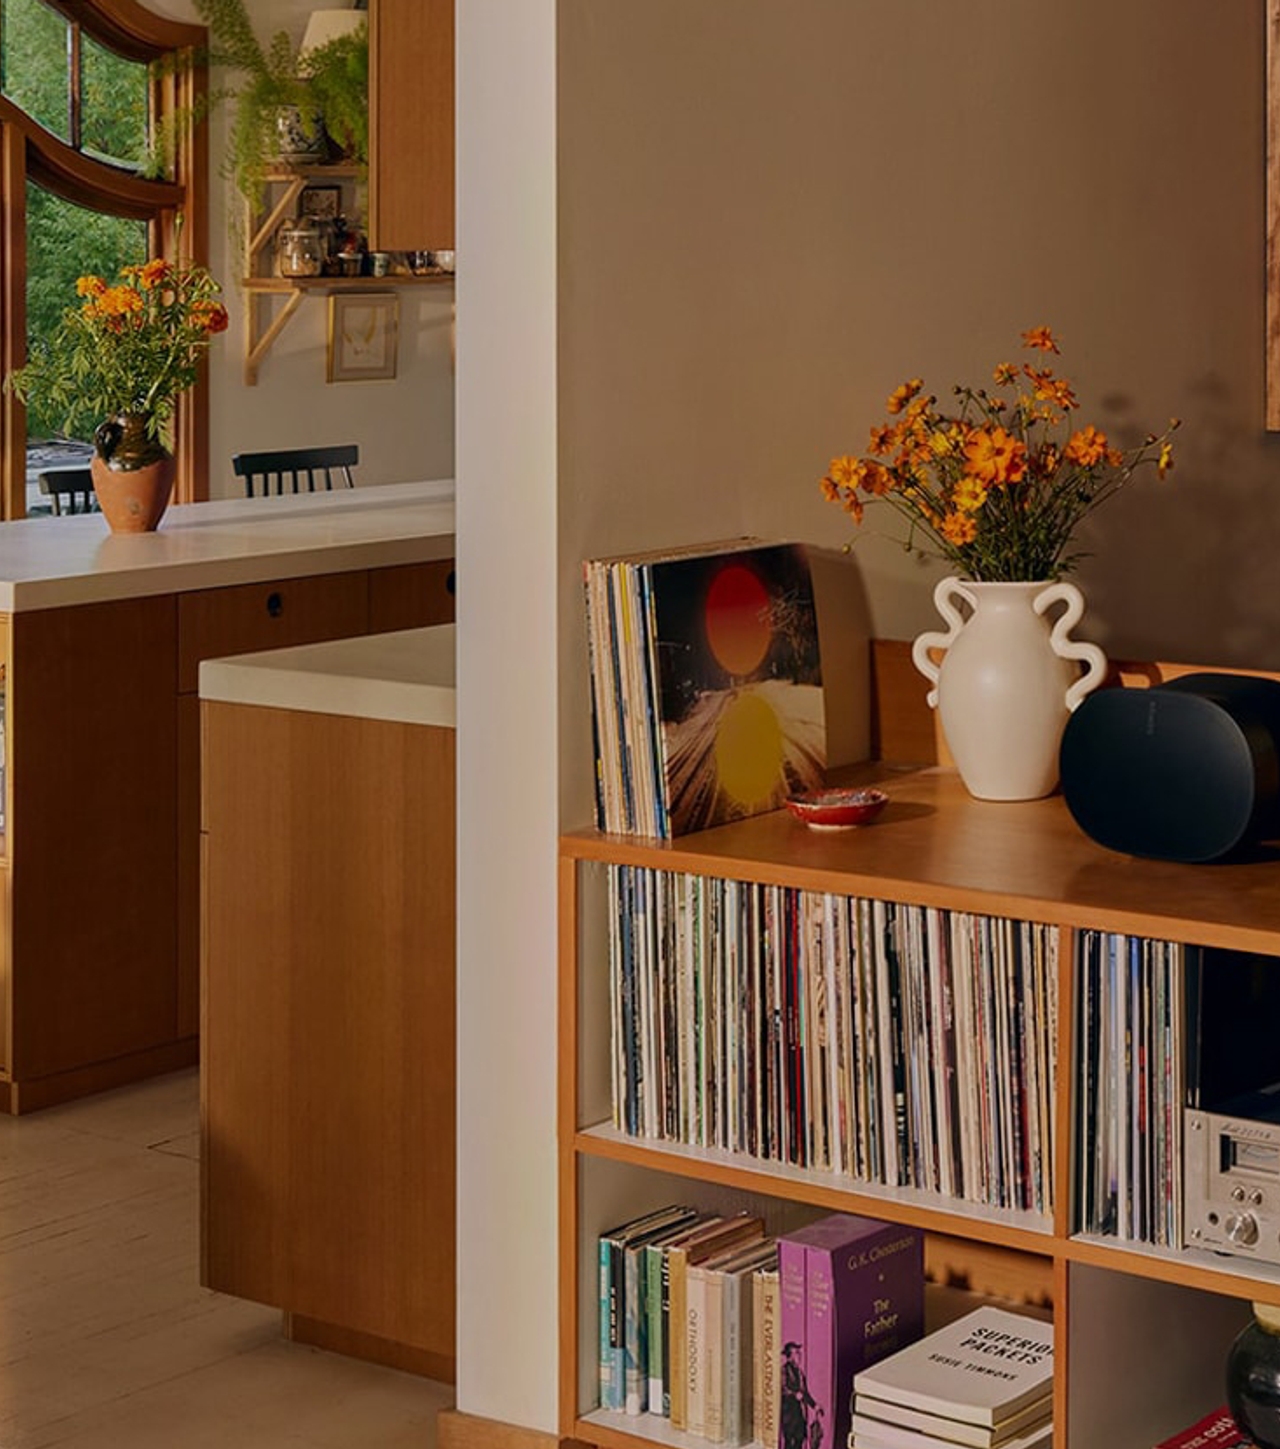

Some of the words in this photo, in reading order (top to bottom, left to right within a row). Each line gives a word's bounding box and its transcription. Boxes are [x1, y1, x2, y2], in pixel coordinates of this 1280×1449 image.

[764, 1295, 773, 1317] THE
[873, 1298, 890, 1313] The
[688, 1309, 698, 1393] ORTHODOXY
[763, 1320, 773, 1397] EVERLASTING
[960, 1338, 1042, 1366] PACKETS
[928, 1353, 961, 1368] SUSIE
[965, 1363, 1018, 1381] TIMMONS
[763, 1399, 773, 1432] MAN
